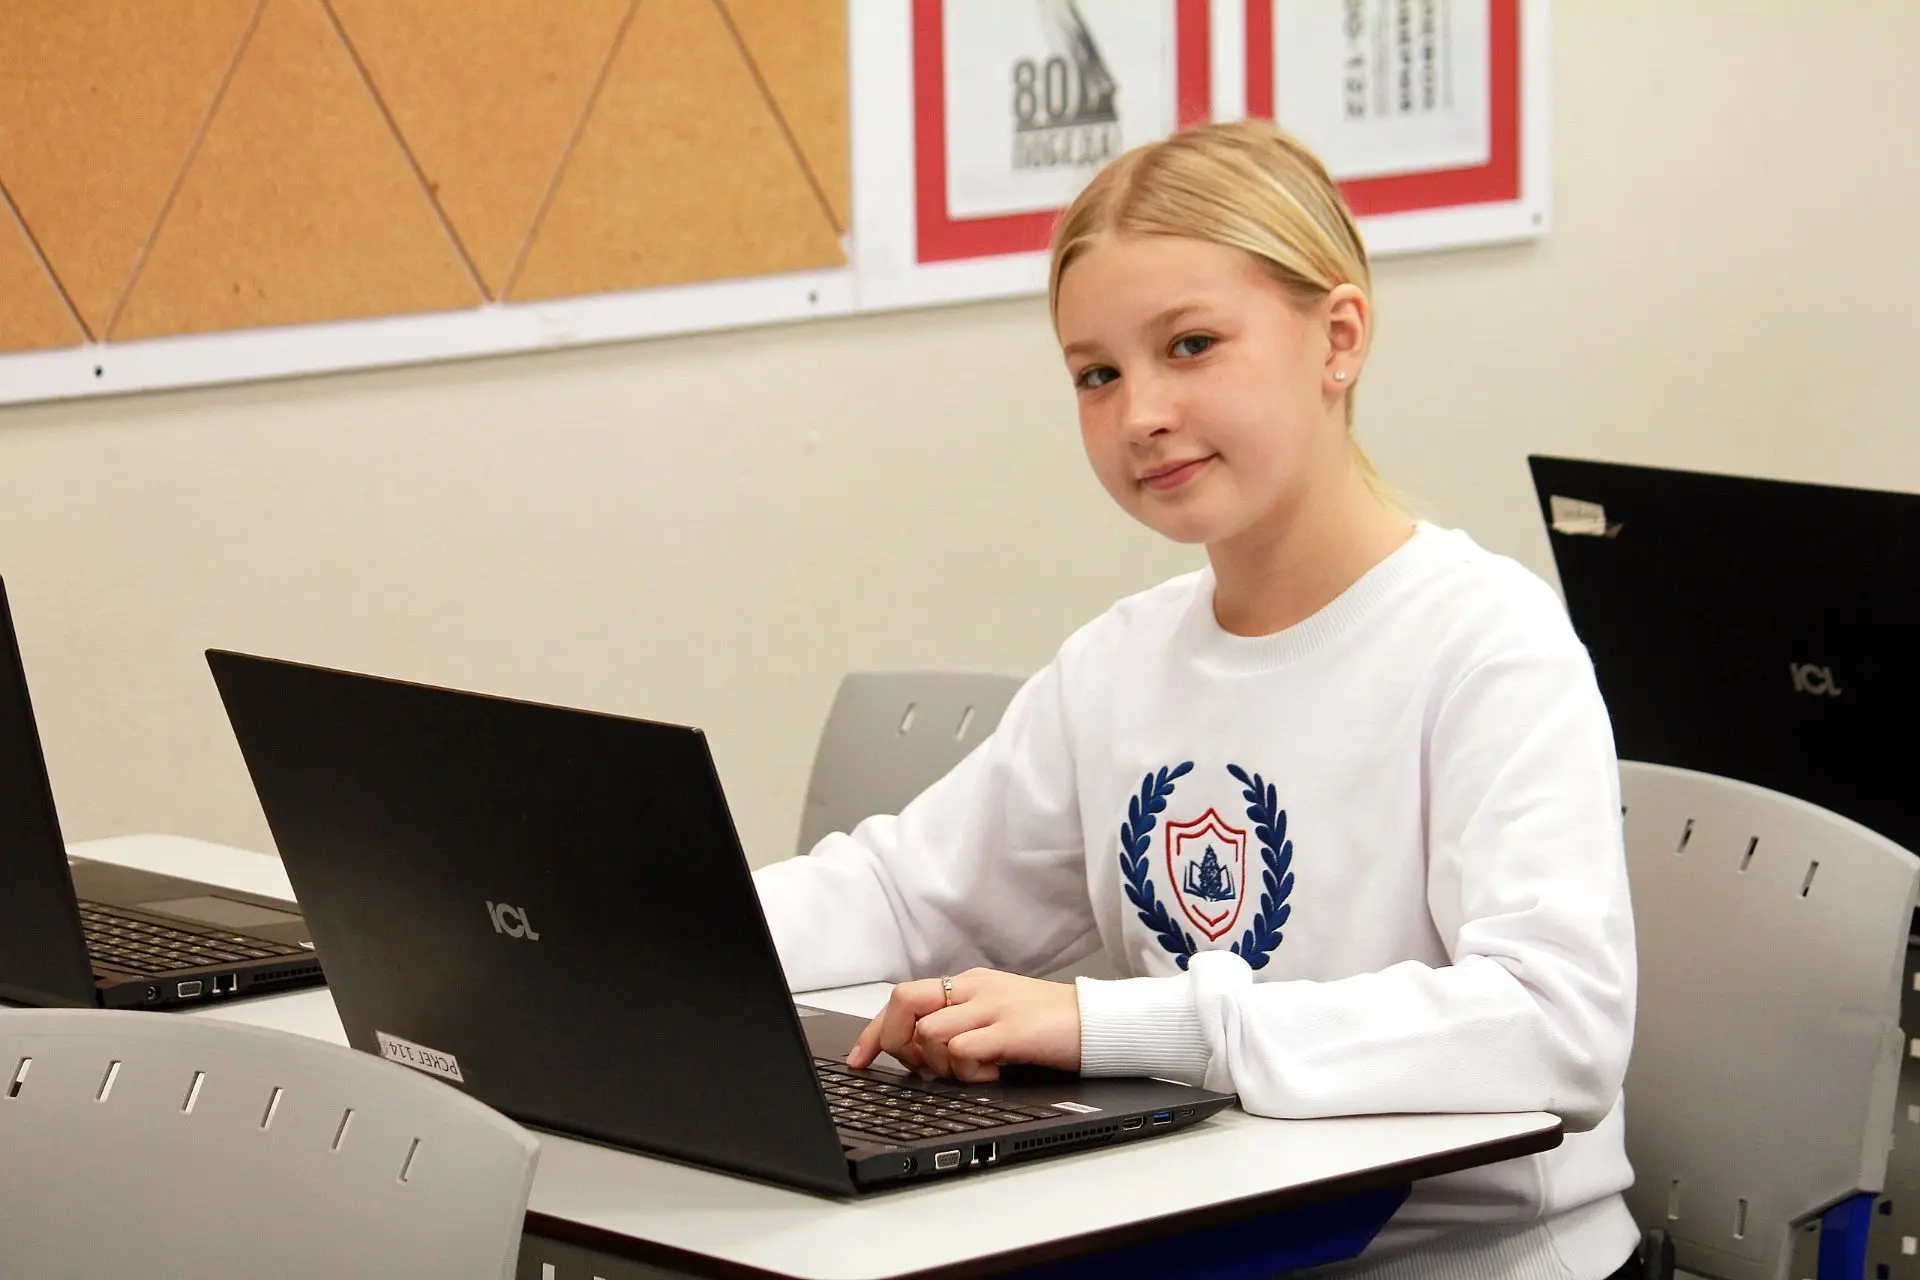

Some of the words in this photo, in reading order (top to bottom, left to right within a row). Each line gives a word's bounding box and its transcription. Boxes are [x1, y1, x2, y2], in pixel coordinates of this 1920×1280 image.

[1013, 57, 1068, 123] 80
[1790, 661, 1843, 697] ICL
[486, 900, 540, 941] ICL
[387, 1040, 414, 1060] 114
